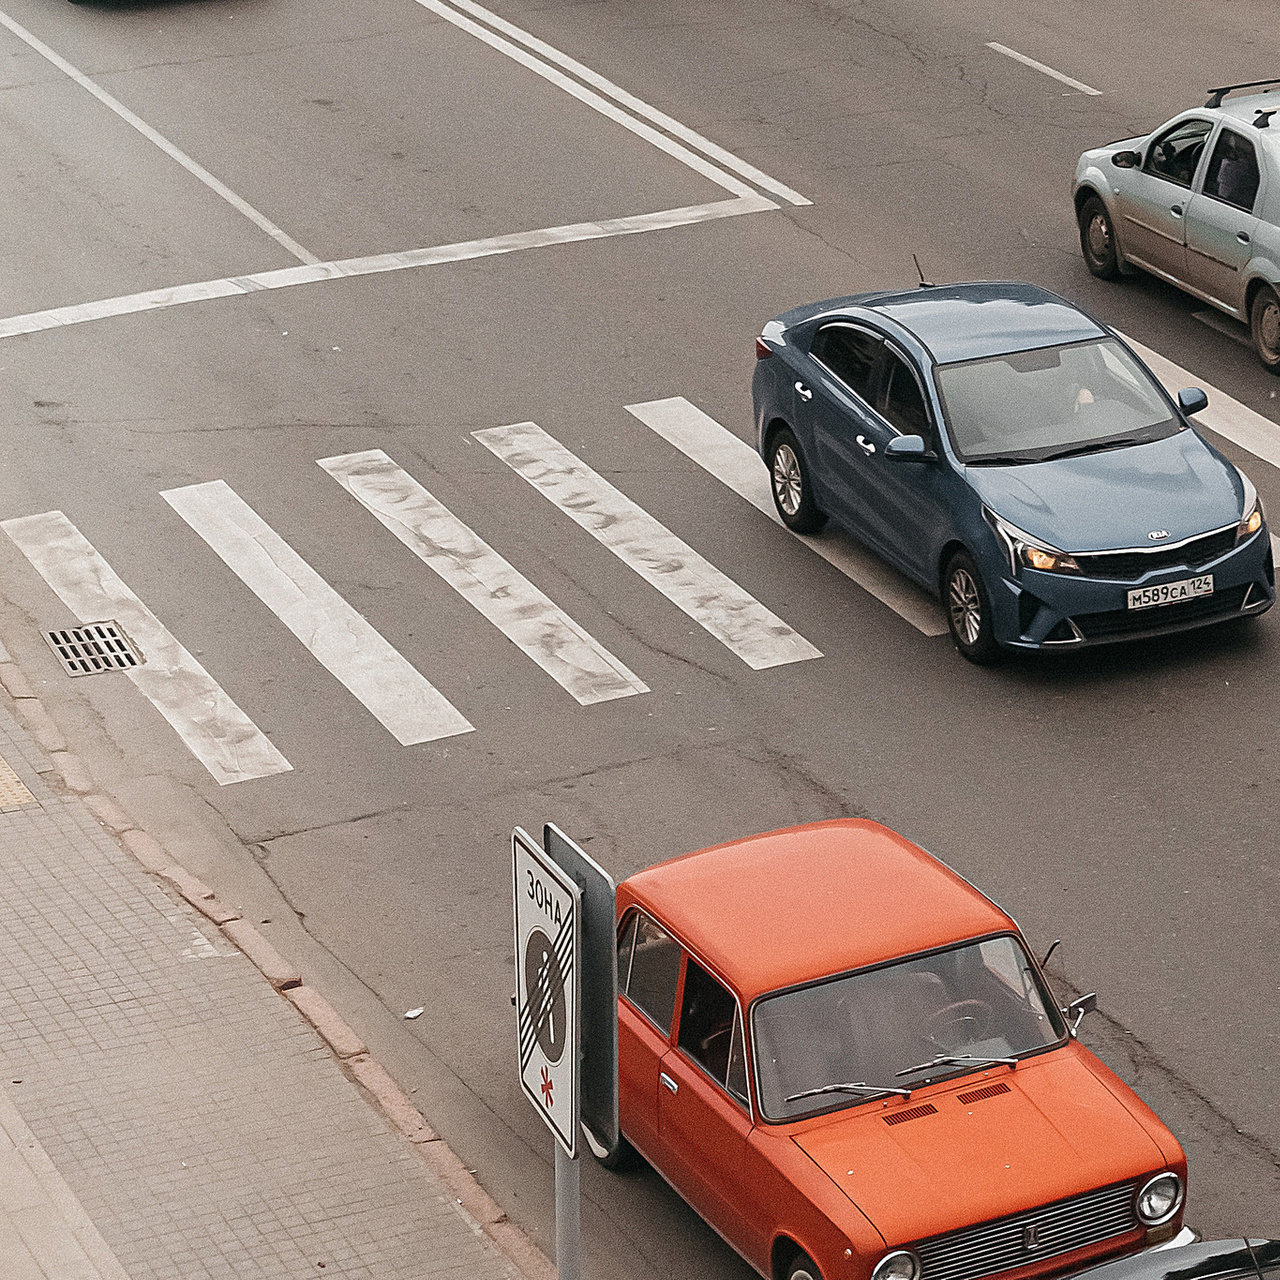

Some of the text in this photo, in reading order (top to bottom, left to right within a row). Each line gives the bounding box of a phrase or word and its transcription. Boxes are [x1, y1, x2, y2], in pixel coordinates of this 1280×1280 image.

[1132, 577, 1212, 607] М589СА 124
[526, 869, 563, 928] ЗОНА
